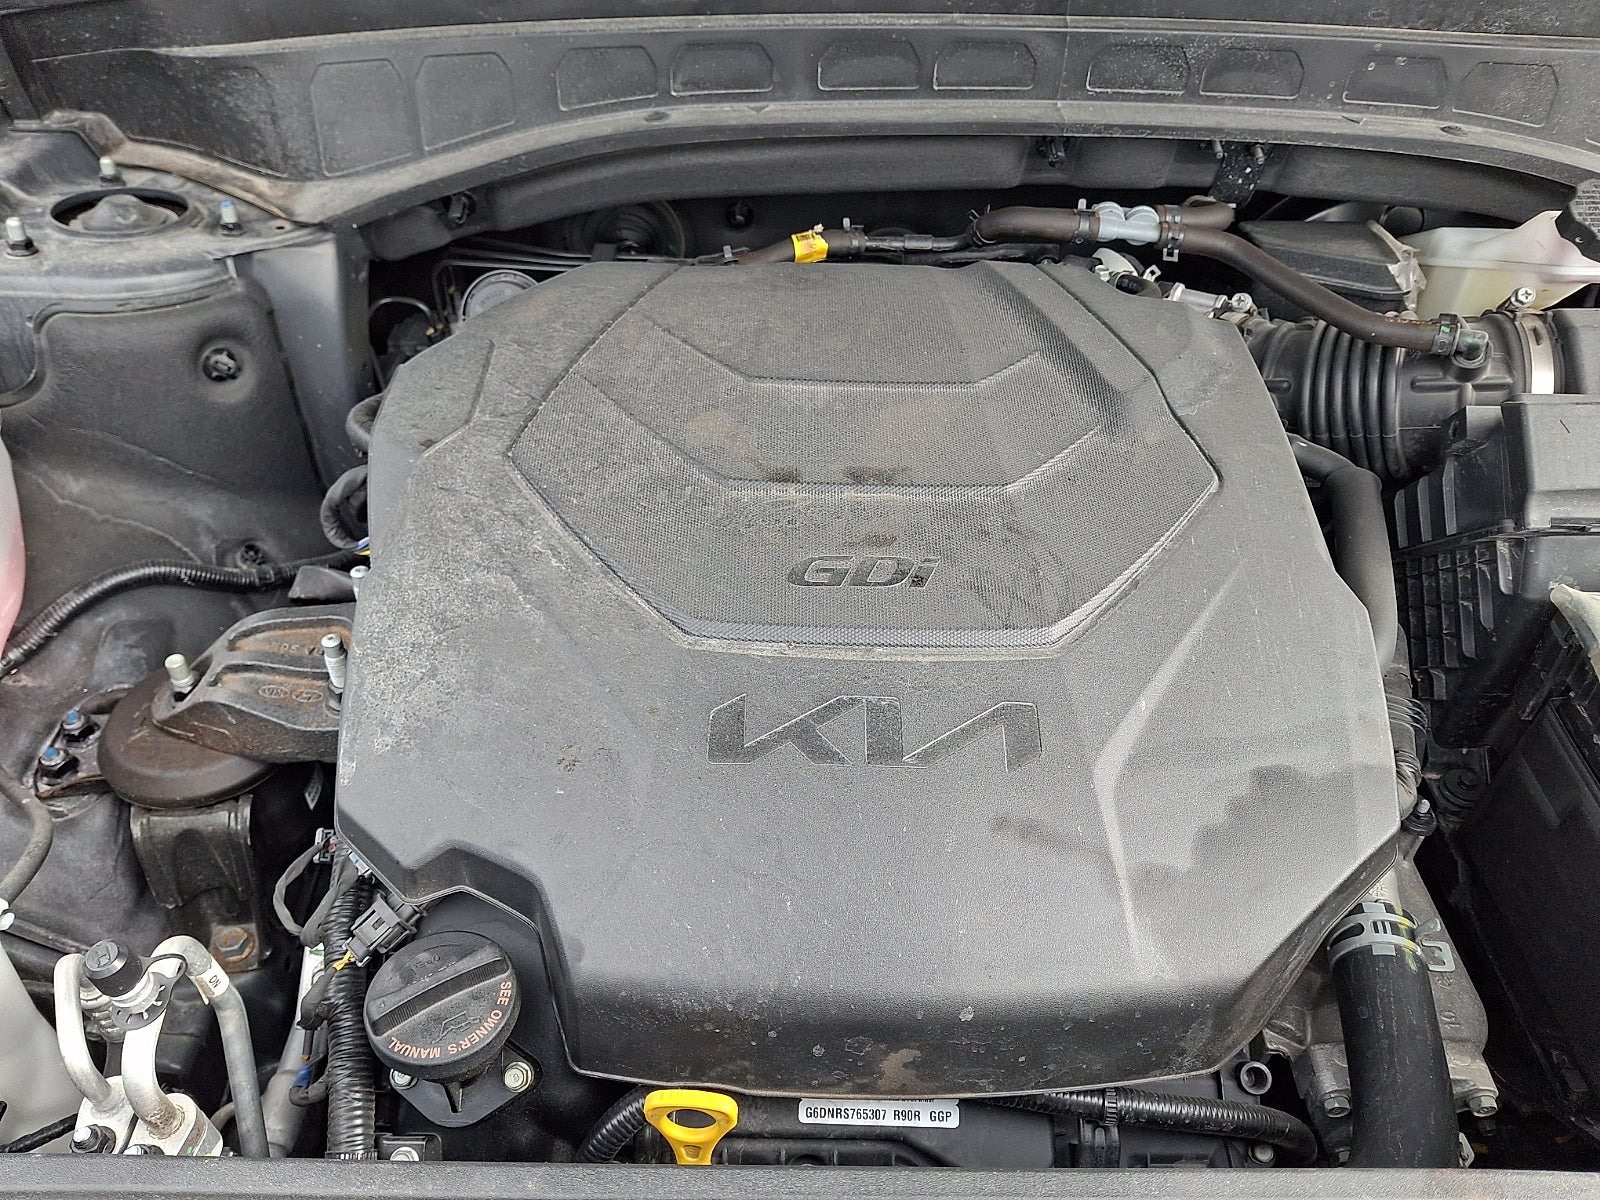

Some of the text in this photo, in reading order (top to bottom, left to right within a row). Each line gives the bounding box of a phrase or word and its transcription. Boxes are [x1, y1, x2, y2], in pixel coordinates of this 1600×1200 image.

[787, 555, 942, 589] GDi
[706, 693, 1042, 773] KIA
[388, 981, 512, 1059] SEE OWNER'S MANUAL
[805, 1106, 952, 1123] G6DNRS765307 R90R GGP
